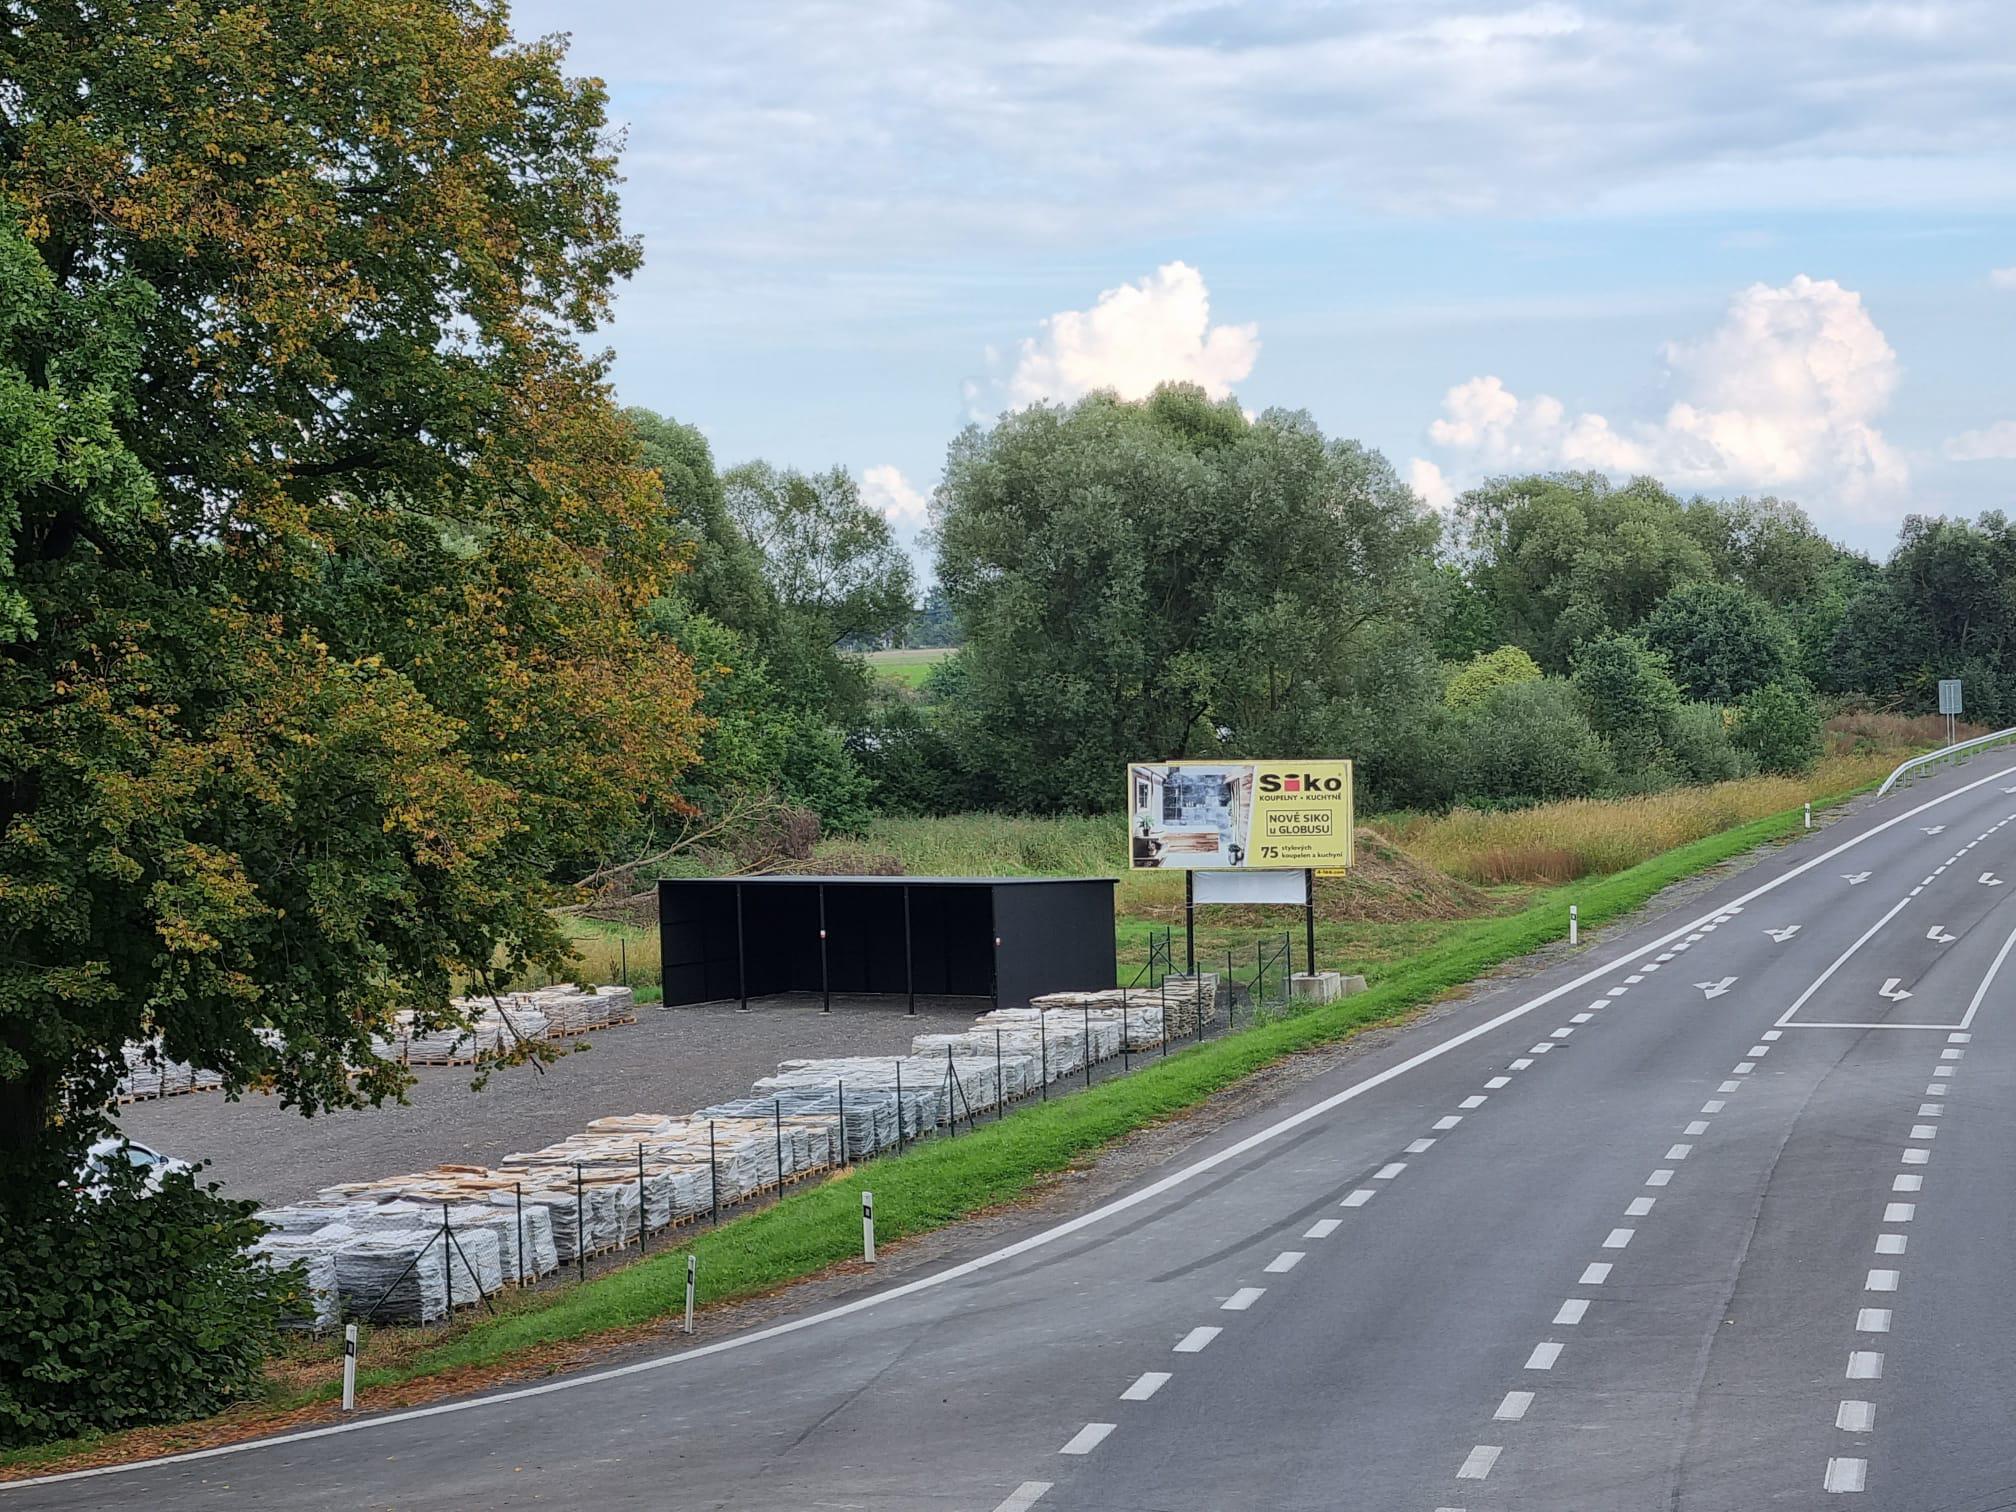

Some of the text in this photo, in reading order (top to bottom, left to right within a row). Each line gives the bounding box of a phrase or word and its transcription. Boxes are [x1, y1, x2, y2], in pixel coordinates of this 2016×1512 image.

[1269, 812, 1329, 823] NOVÉ SIKO
[1279, 825, 1330, 834] GLOBUSU
[1261, 846, 1279, 858] 75
